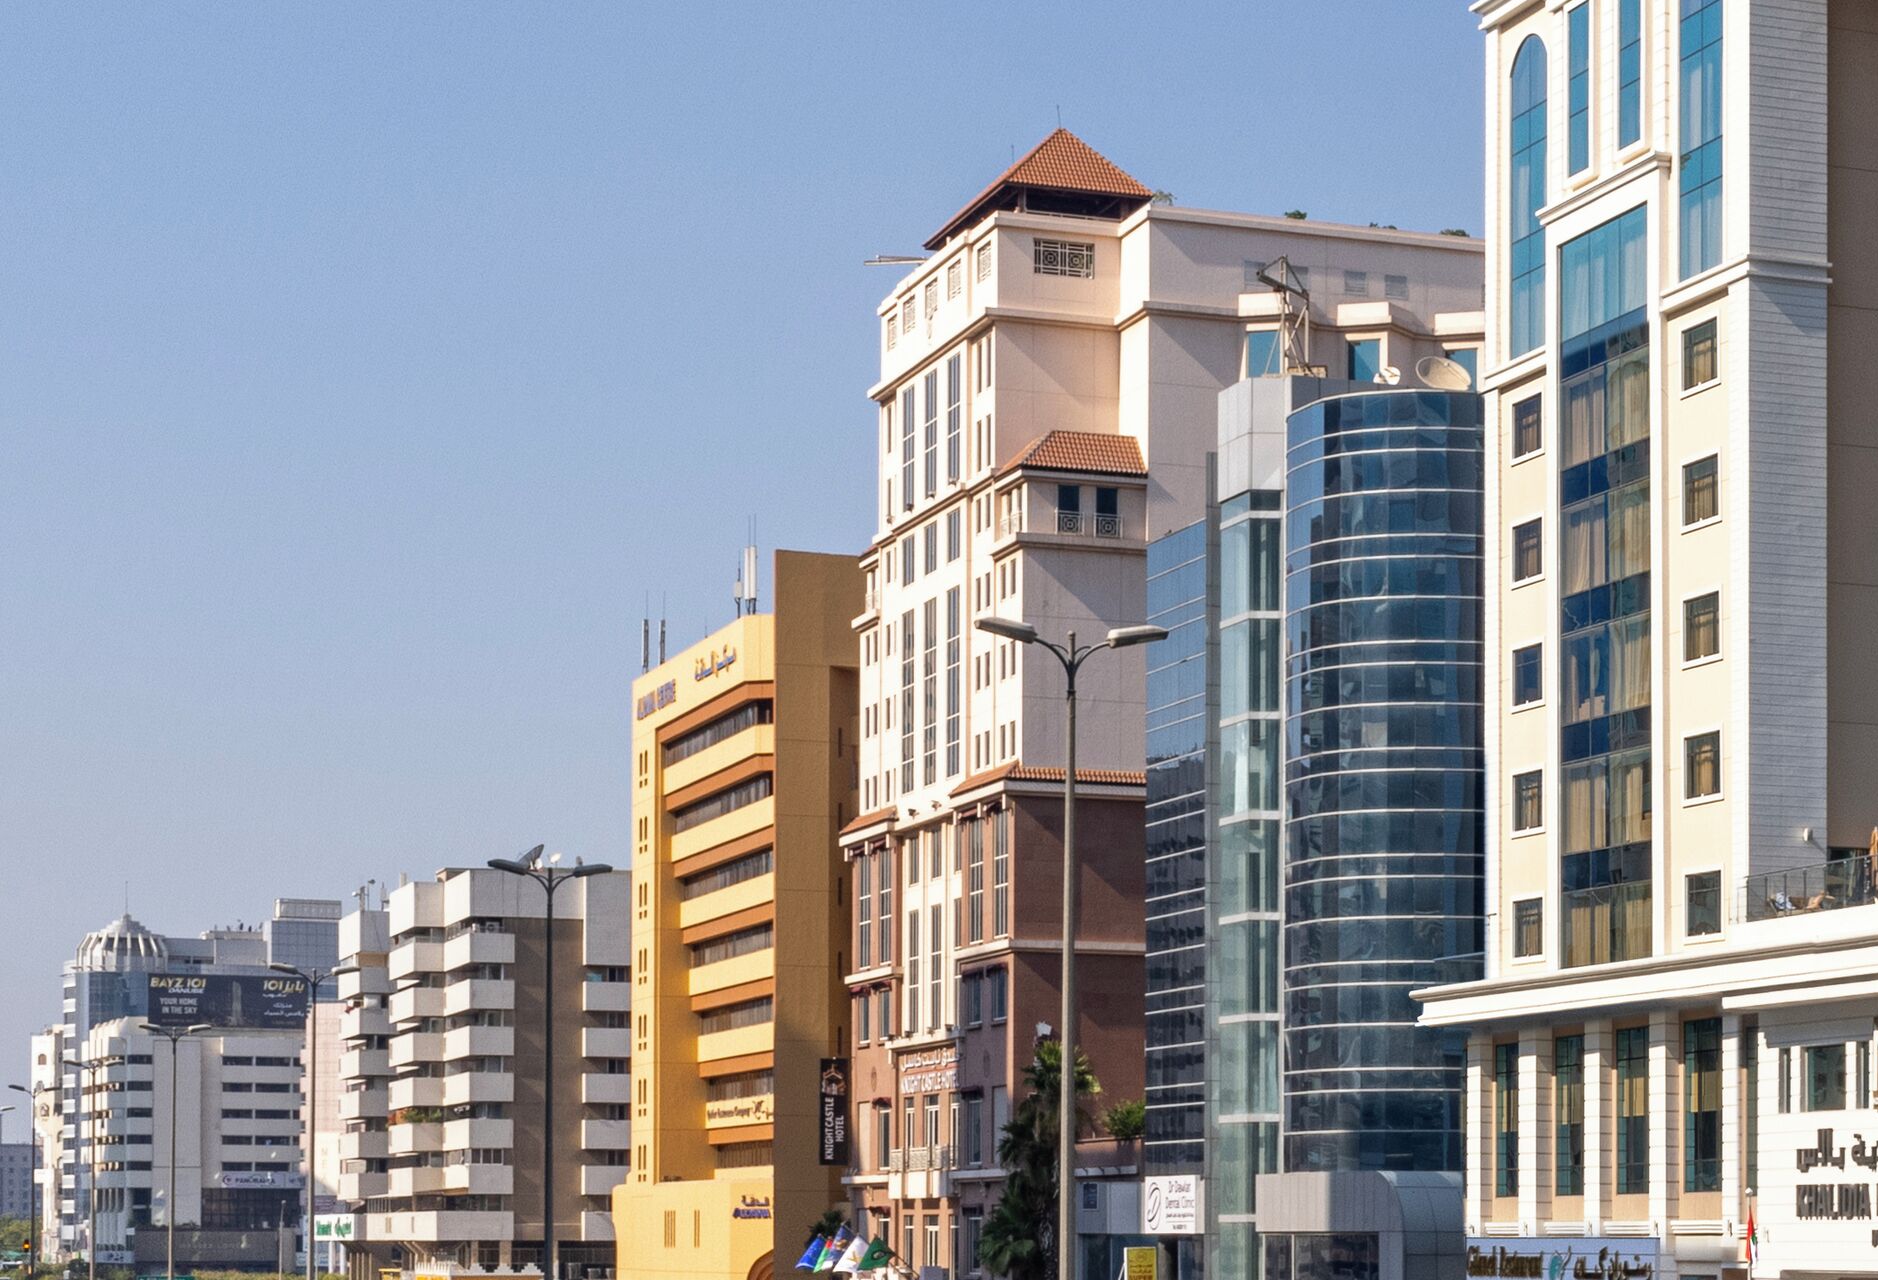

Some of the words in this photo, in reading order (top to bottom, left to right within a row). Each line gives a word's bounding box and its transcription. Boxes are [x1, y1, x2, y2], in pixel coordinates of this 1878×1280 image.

[150, 977, 183, 989] BAYZ
[186, 977, 207, 988] 101
[262, 980, 283, 992] 101
[160, 997, 178, 1005] YOUR
[162, 1006, 170, 1015] IN
[170, 1006, 185, 1015] THE
[185, 1007, 198, 1015] SKY
[824, 1097, 835, 1128] CASTLE
[834, 1115, 845, 1143] HOTEL
[824, 1128, 835, 1160] KNIGHT
[1796, 1182, 1872, 1220] KHALIDIA
